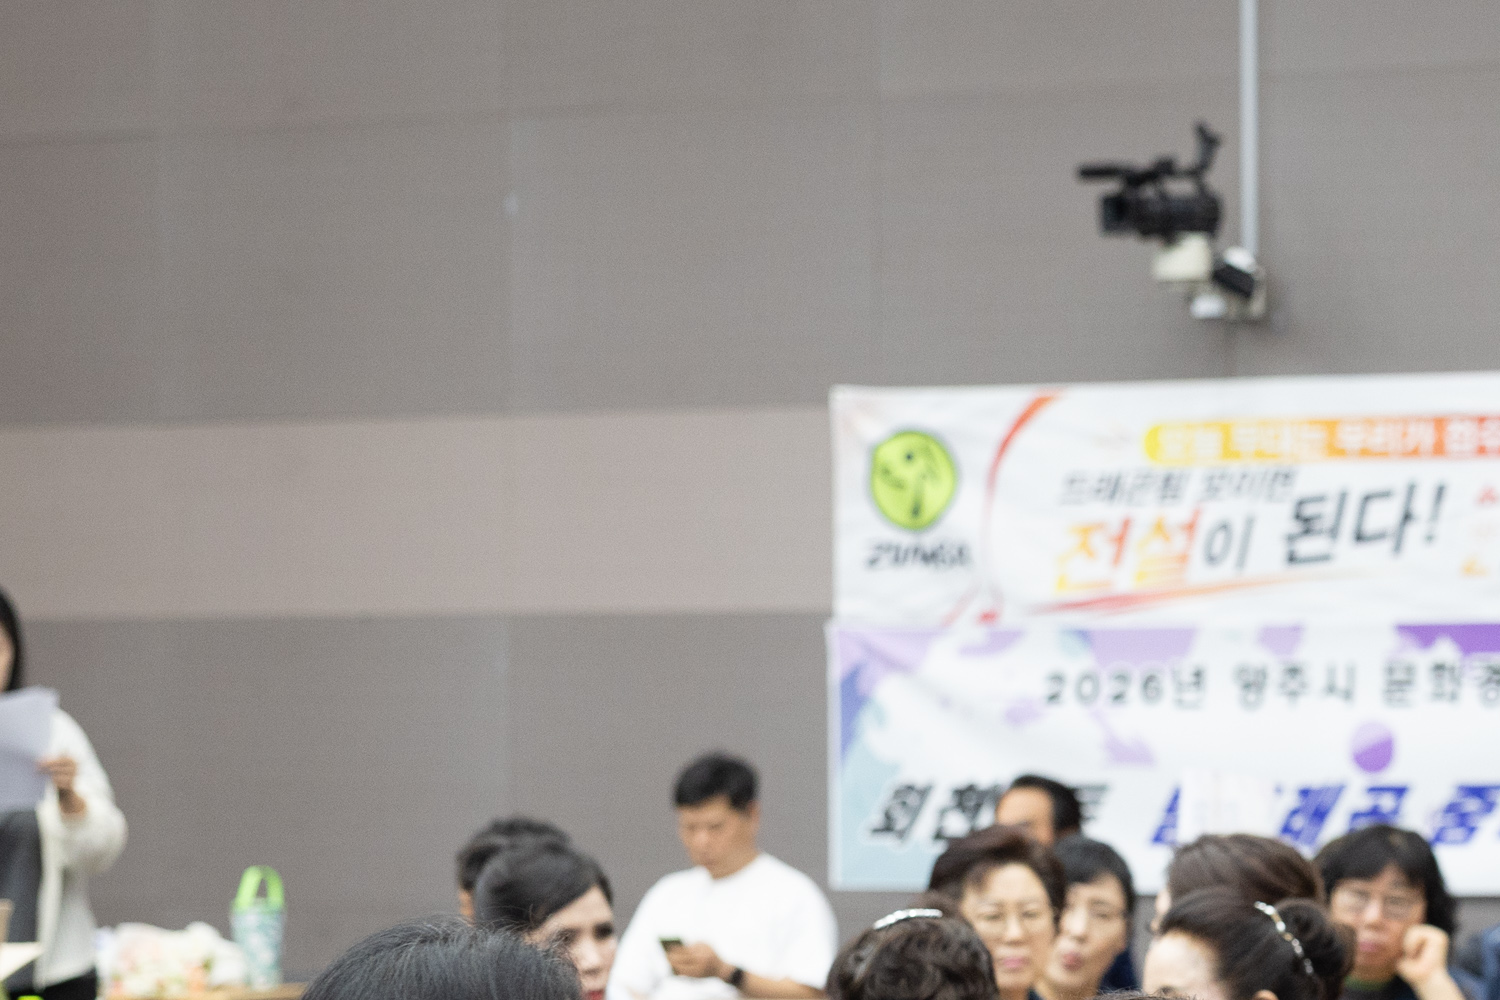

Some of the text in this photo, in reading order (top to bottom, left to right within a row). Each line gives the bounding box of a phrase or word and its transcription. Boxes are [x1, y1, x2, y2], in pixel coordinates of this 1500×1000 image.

[1055, 480, 1448, 592] 전설이 된다!
[1045, 663, 1207, 710] 2026년
